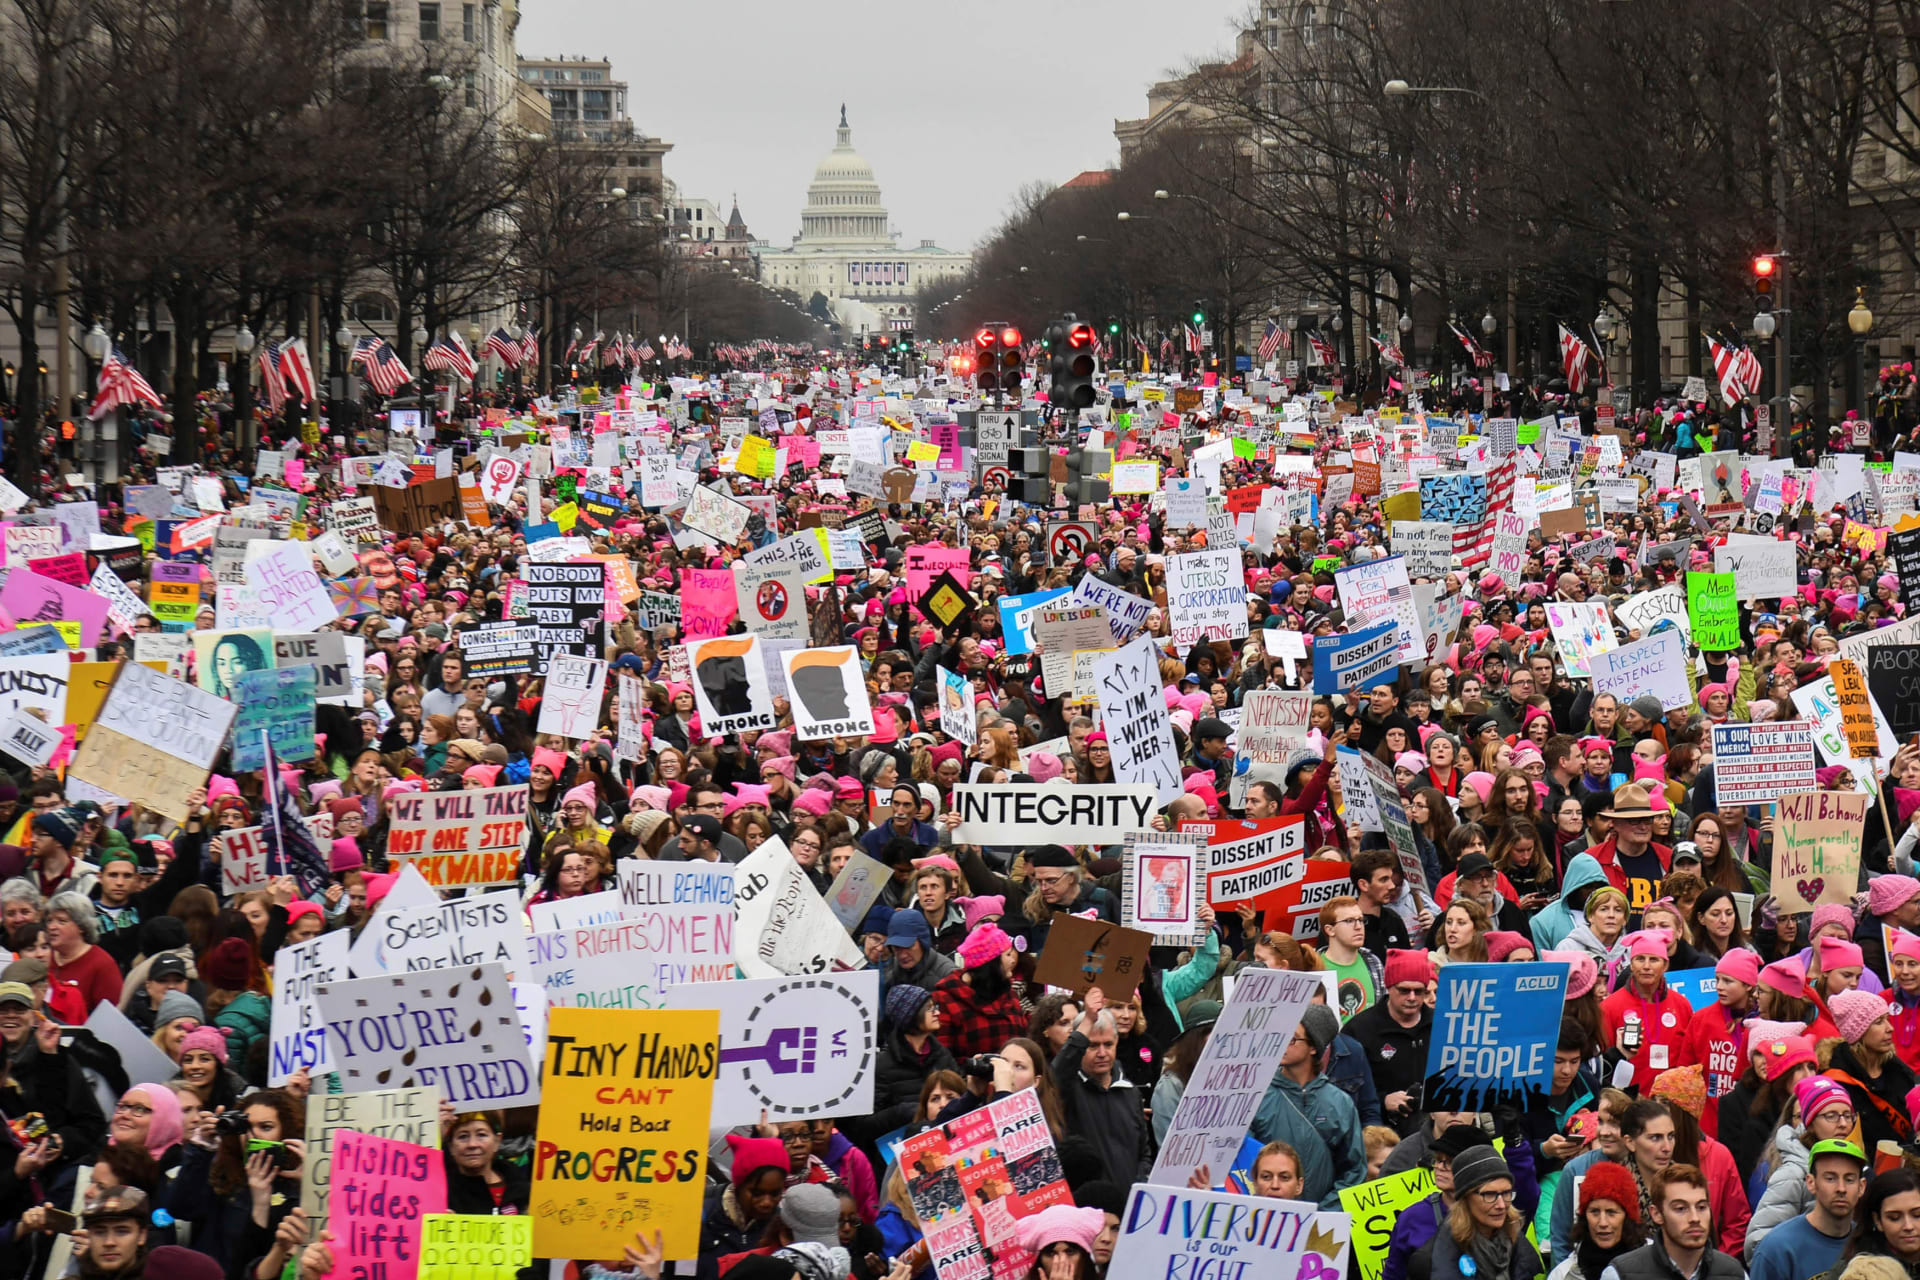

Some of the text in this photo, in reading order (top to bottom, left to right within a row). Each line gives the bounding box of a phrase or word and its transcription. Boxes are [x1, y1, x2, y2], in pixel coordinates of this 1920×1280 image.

[980, 415, 999, 424] THRU
[980, 442, 1018, 450] OBEY THIS
[980, 452, 1005, 461] SIGNAL
[1355, 464, 1378, 472] WOMEN
[586, 503, 615, 516] FIGHT
[1209, 514, 1229, 529] NOT
[1502, 514, 1523, 536] PRO
[1209, 530, 1235, 542] THIS
[1407, 526, 1450, 541] not free
[754, 540, 805, 565] THIS IS
[1187, 556, 1210, 569] make
[1215, 556, 1229, 572] my
[1412, 548, 1427, 558] any
[1497, 552, 1520, 572] PRO
[256, 552, 294, 585] HE
[529, 568, 599, 581] NOBODY
[1360, 562, 1395, 579] MARCH
[1412, 560, 1448, 574] unfree
[1181, 570, 1226, 589] UTERUS
[1360, 580, 1383, 592] FOR
[258, 570, 320, 616] STARTED
[529, 589, 603, 601] PUTS MY
[1060, 597, 1069, 607] IS
[1084, 583, 1150, 622] WE'RE NOT
[1179, 586, 1246, 609] CORPORATION
[1346, 594, 1390, 614] AMERICAN
[285, 597, 317, 626] IT
[1044, 608, 1101, 623] LOVE IS LOVE
[1193, 613, 1207, 626] you
[1212, 608, 1229, 619] stop
[1629, 593, 1684, 628] RESPECT
[1317, 638, 1340, 647] ACLU
[1383, 633, 1393, 645] IS
[1077, 656, 1092, 667] WE
[1337, 643, 1379, 665] DISSENT
[1608, 640, 1666, 673] RESPECT
[556, 660, 587, 675] FUCK
[558, 673, 579, 684] OFF
[1074, 671, 1094, 680] NEED
[1344, 655, 1392, 685] PATRIOTIC
[1597, 660, 1666, 693] EXISTENCE
[1125, 692, 1148, 719] I'M
[1246, 696, 1310, 727] NARCISSISM
[707, 714, 771, 733] WRONG
[802, 721, 870, 736] WRONG
[942, 716, 977, 746] HUMAN
[1121, 710, 1160, 744] WITH
[12, 727, 48, 752] ALLY
[1243, 737, 1274, 750] MENTAL
[1715, 729, 1749, 743] IN OUR
[1752, 732, 1811, 745] LOVE WINS
[1131, 735, 1161, 765] HER
[1716, 743, 1750, 754] AMERICA
[1718, 764, 1759, 774] DISABILITIES
[1776, 761, 1812, 770] RESPECTED
[1348, 788, 1366, 799] WITH
[1350, 799, 1366, 809] HER
[1718, 789, 1756, 801] DIVERSITY
[1760, 790, 1767, 798] IS
[396, 790, 527, 821] WE WILL TAKE
[955, 788, 1153, 826] INTEGRITY
[1779, 793, 1865, 822] Well Behaved
[389, 821, 524, 853] NOT ONE STEP
[1184, 824, 1214, 834] ACLU
[1212, 831, 1294, 866] DISSENT IS
[1781, 850, 1807, 879] Make
[617, 872, 734, 905] WELL BEHAVED
[1221, 862, 1293, 896] PATRIOTIC
[386, 900, 508, 949] SCIENTISTS
[495, 942, 511, 960] A
[576, 924, 649, 959] RIGHTS
[293, 942, 322, 973] THE
[546, 968, 576, 989] ARE
[1233, 972, 1276, 1003] THOU
[1449, 977, 1559, 1011] WE ACLU
[300, 1005, 312, 1028] IS
[1238, 1006, 1272, 1030] NOT
[328, 1002, 465, 1057] YOU'RE
[1444, 1013, 1501, 1045] THE
[831, 1029, 847, 1058] WE
[1205, 1032, 1291, 1060] MESS WITH
[548, 1033, 716, 1080] TINY HANDS
[1439, 1043, 1547, 1078] PEOPLE
[416, 1059, 529, 1102] FIRED
[324, 1092, 423, 1122] BE THE
[596, 1086, 673, 1105] CAN'T
[992, 1091, 1037, 1120] WOMEN'S
[1172, 1091, 1263, 1130] REPRODUCTIVE
[580, 1113, 672, 1133] Hold Back
[1001, 1113, 1043, 1137] ARE
[903, 1134, 942, 1157] WOMEN
[1003, 1123, 1048, 1151] HUMAN
[338, 1136, 429, 1182] rising
[536, 1140, 699, 1183] PROGRESS
[1160, 1133, 1206, 1169] RIGHTS
[963, 1162, 1004, 1184] WOMEN
[344, 1178, 420, 1220] tides
[1024, 1186, 1066, 1209] WOMEN
[1354, 1183, 1394, 1211] WE
[428, 1219, 525, 1246] THE FUTURE IS
[1126, 1190, 1313, 1253] DIVERSITY
[351, 1221, 409, 1261] lift
[1186, 1238, 1238, 1256] is our
[938, 1243, 983, 1269] ARE
